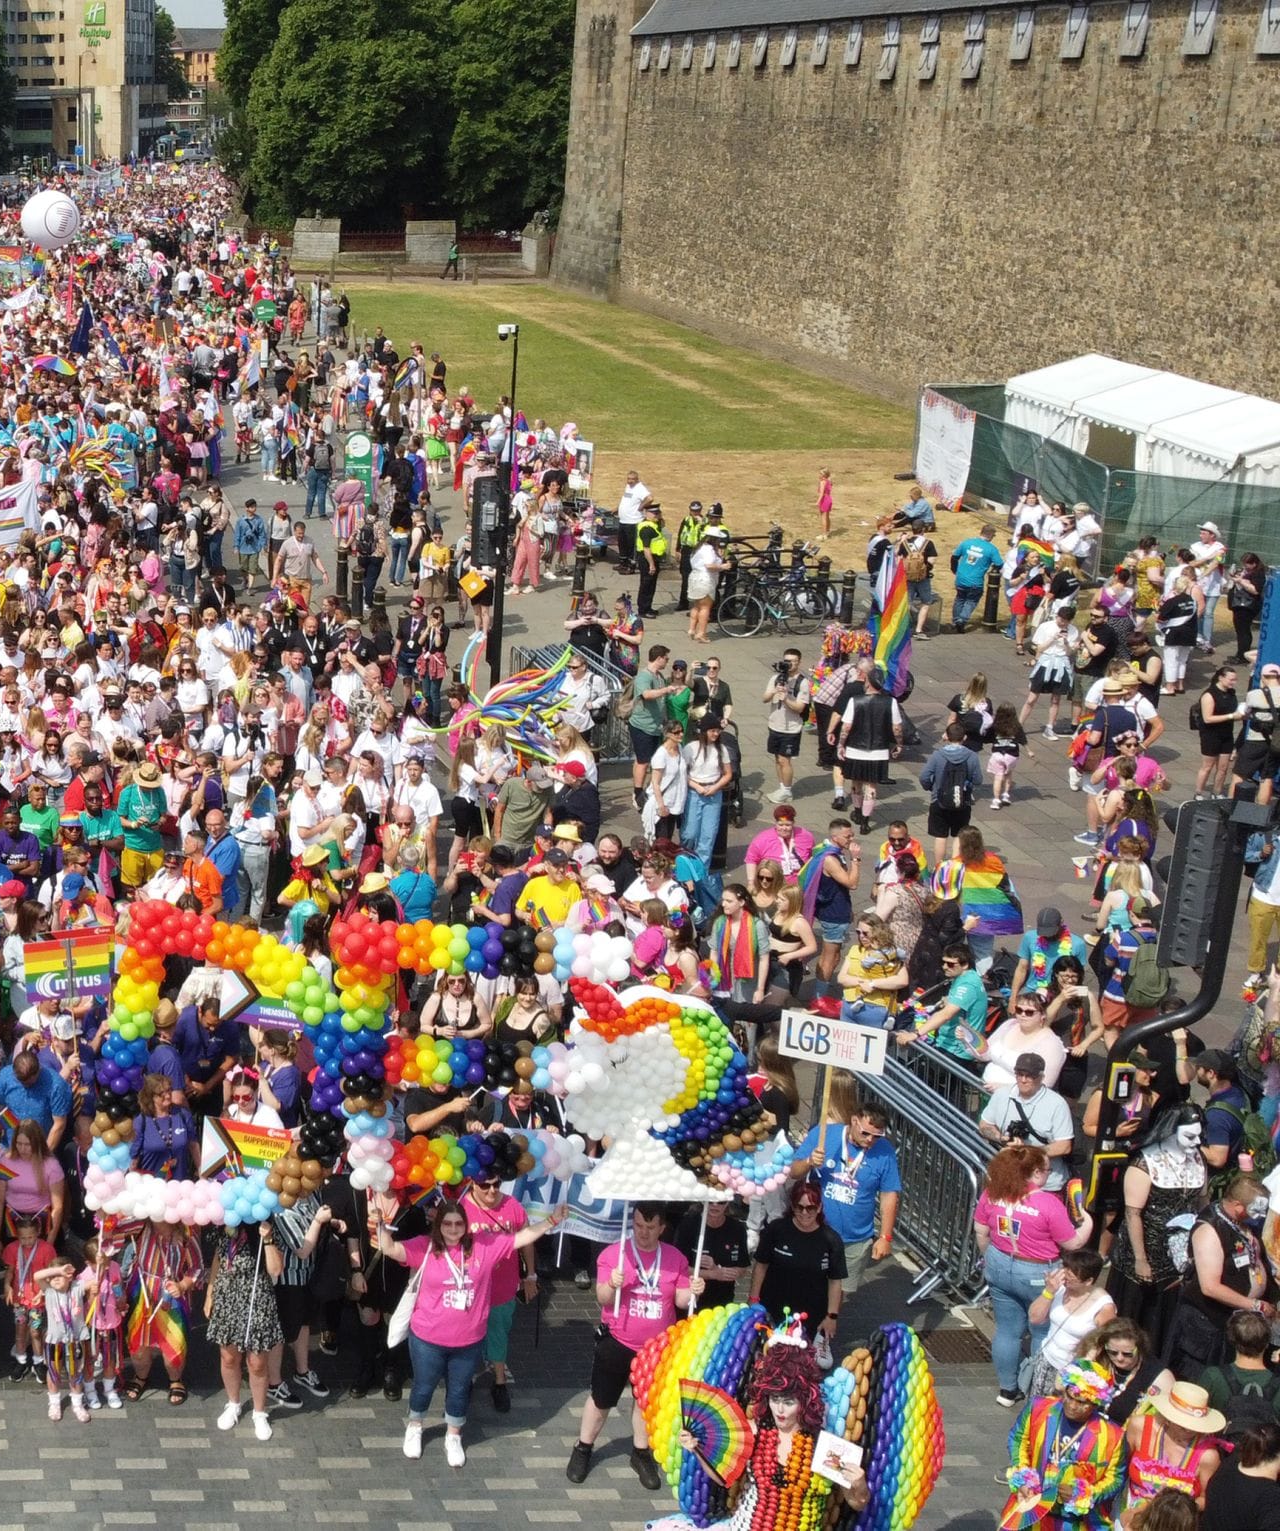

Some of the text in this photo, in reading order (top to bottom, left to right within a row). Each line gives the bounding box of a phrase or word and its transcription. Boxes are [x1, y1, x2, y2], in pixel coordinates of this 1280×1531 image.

[79, 28, 111, 40] Holiday
[87, 38, 101, 47] Inn
[54, 974, 102, 991] mrus
[260, 1006, 297, 1020] THEMSELVE
[785, 1016, 831, 1055] LGB
[831, 1026, 858, 1044] WITH
[833, 1042, 857, 1061] THE
[861, 1033, 878, 1064] T
[244, 1134, 285, 1149] SUPPORTING
